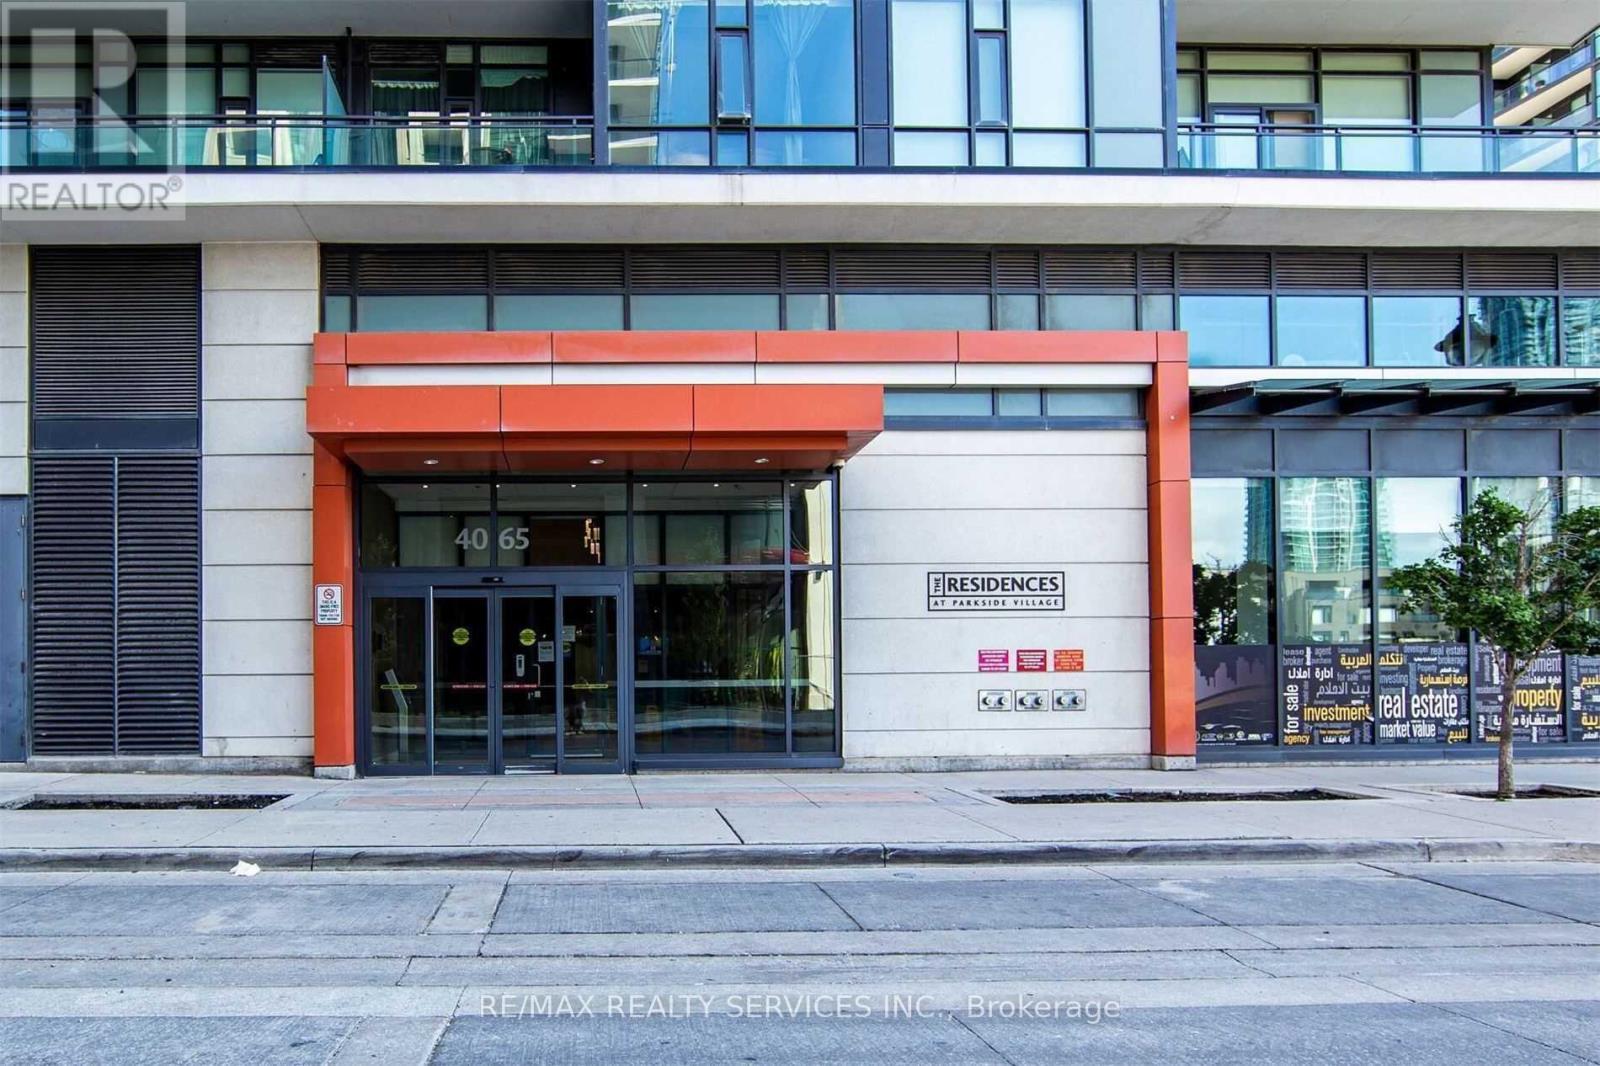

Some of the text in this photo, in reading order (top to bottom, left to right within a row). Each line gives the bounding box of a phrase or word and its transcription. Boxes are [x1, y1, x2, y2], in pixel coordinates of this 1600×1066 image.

[947, 577, 1060, 592] RESIDENCES
[1430, 646, 1444, 656] real
[1446, 646, 1468, 656] estate
[1284, 684, 1300, 734] for sale
[1378, 686, 1458, 718] real estate
[1304, 704, 1371, 721] investment
[1380, 720, 1436, 738] market value
[1448, 728, 1468, 744] للبيع
[1284, 734, 1310, 744] agency
